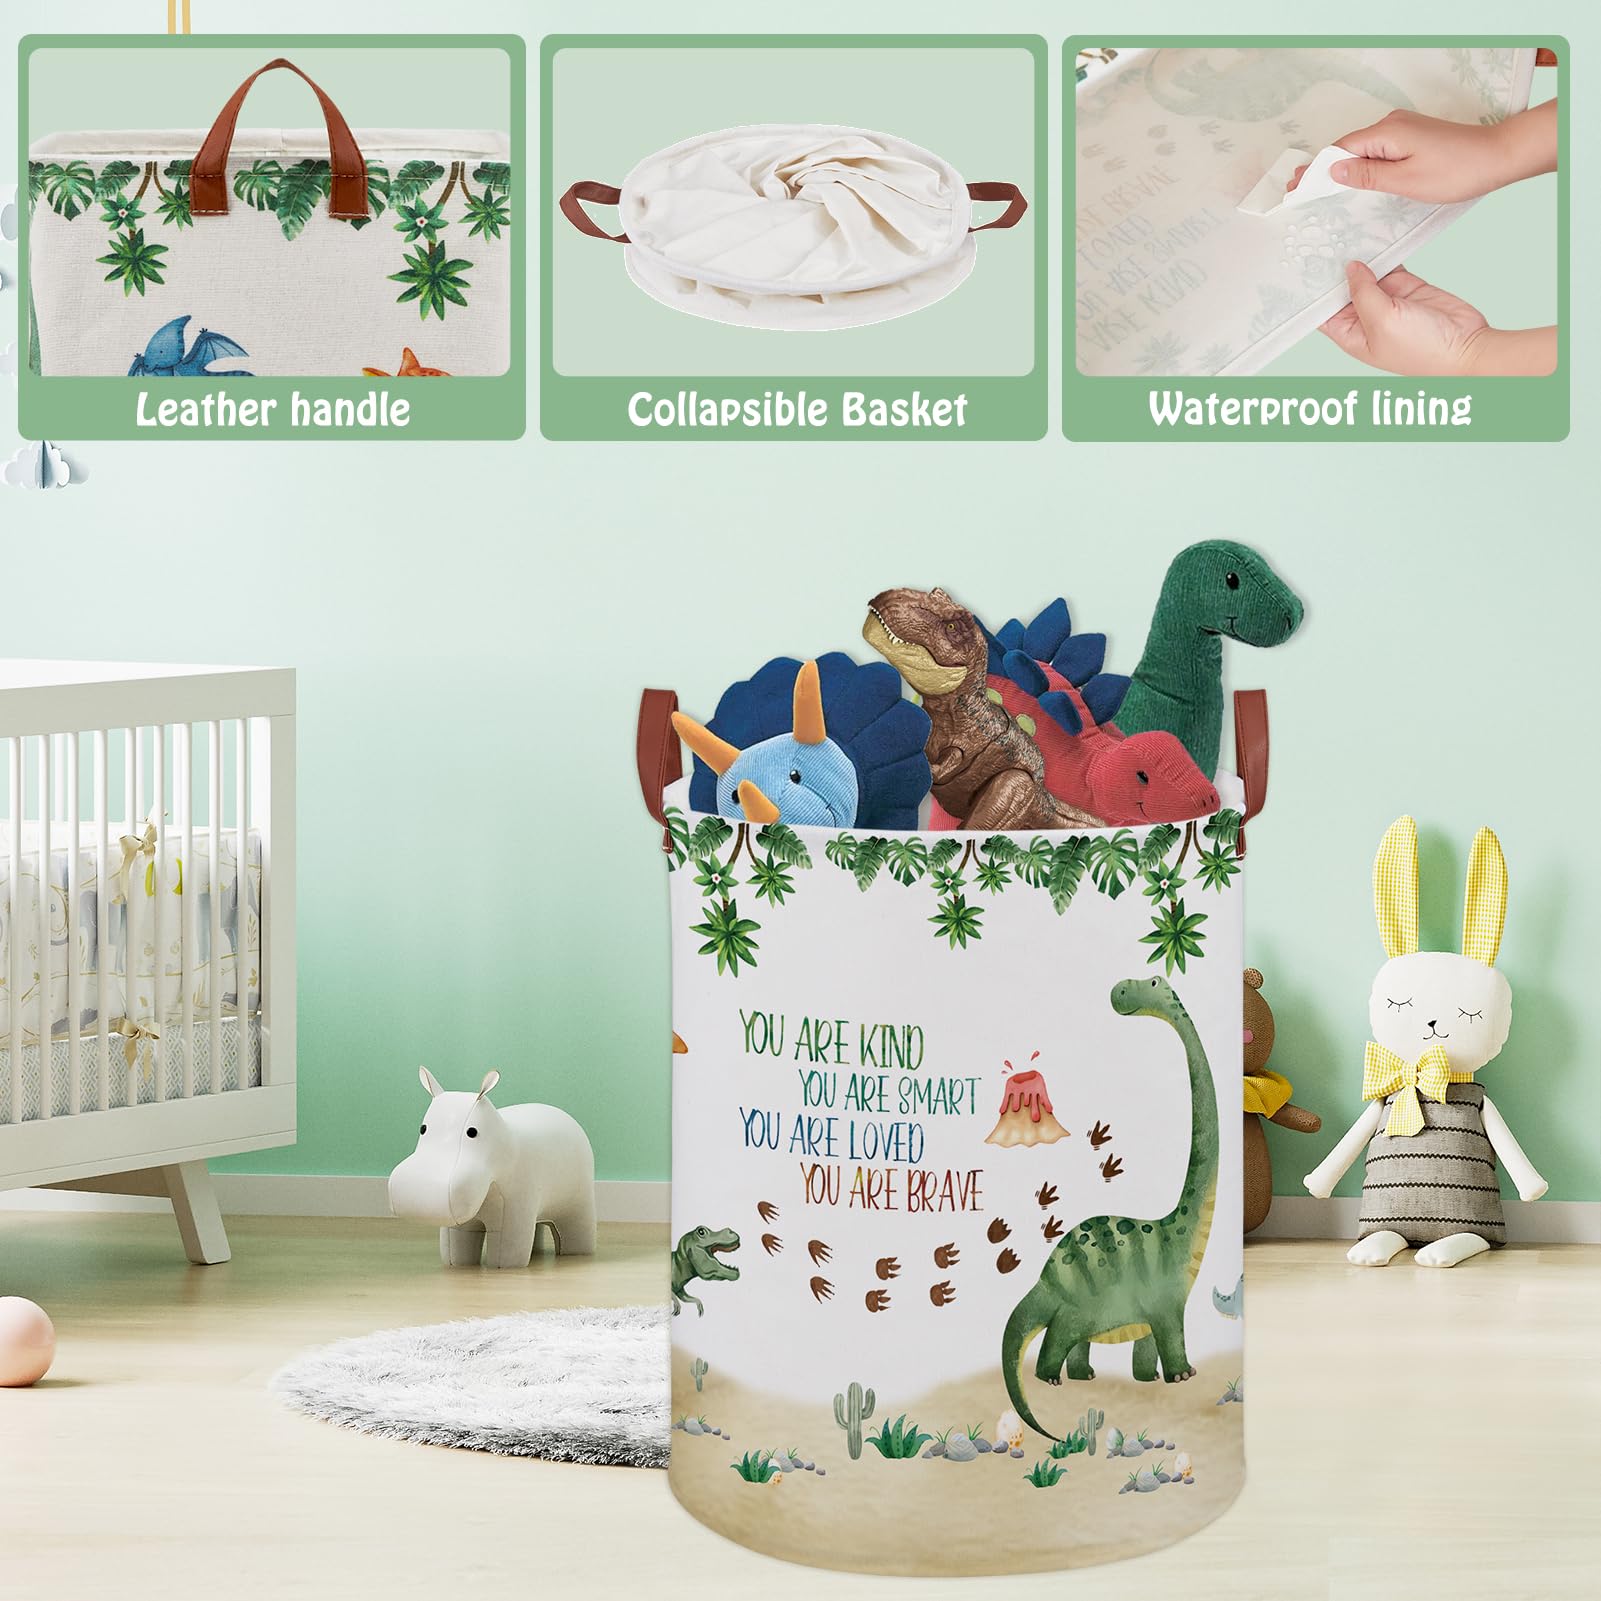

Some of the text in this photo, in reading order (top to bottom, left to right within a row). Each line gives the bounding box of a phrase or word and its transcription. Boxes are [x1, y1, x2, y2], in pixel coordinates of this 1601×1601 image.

[739, 1008, 924, 1070] YOU ARE KIND
[799, 1069, 982, 1115] YOU ARE SMART
[739, 1106, 924, 1164] YOU ARE LOVED
[800, 1162, 984, 1212] YOU ARE BRAVE
